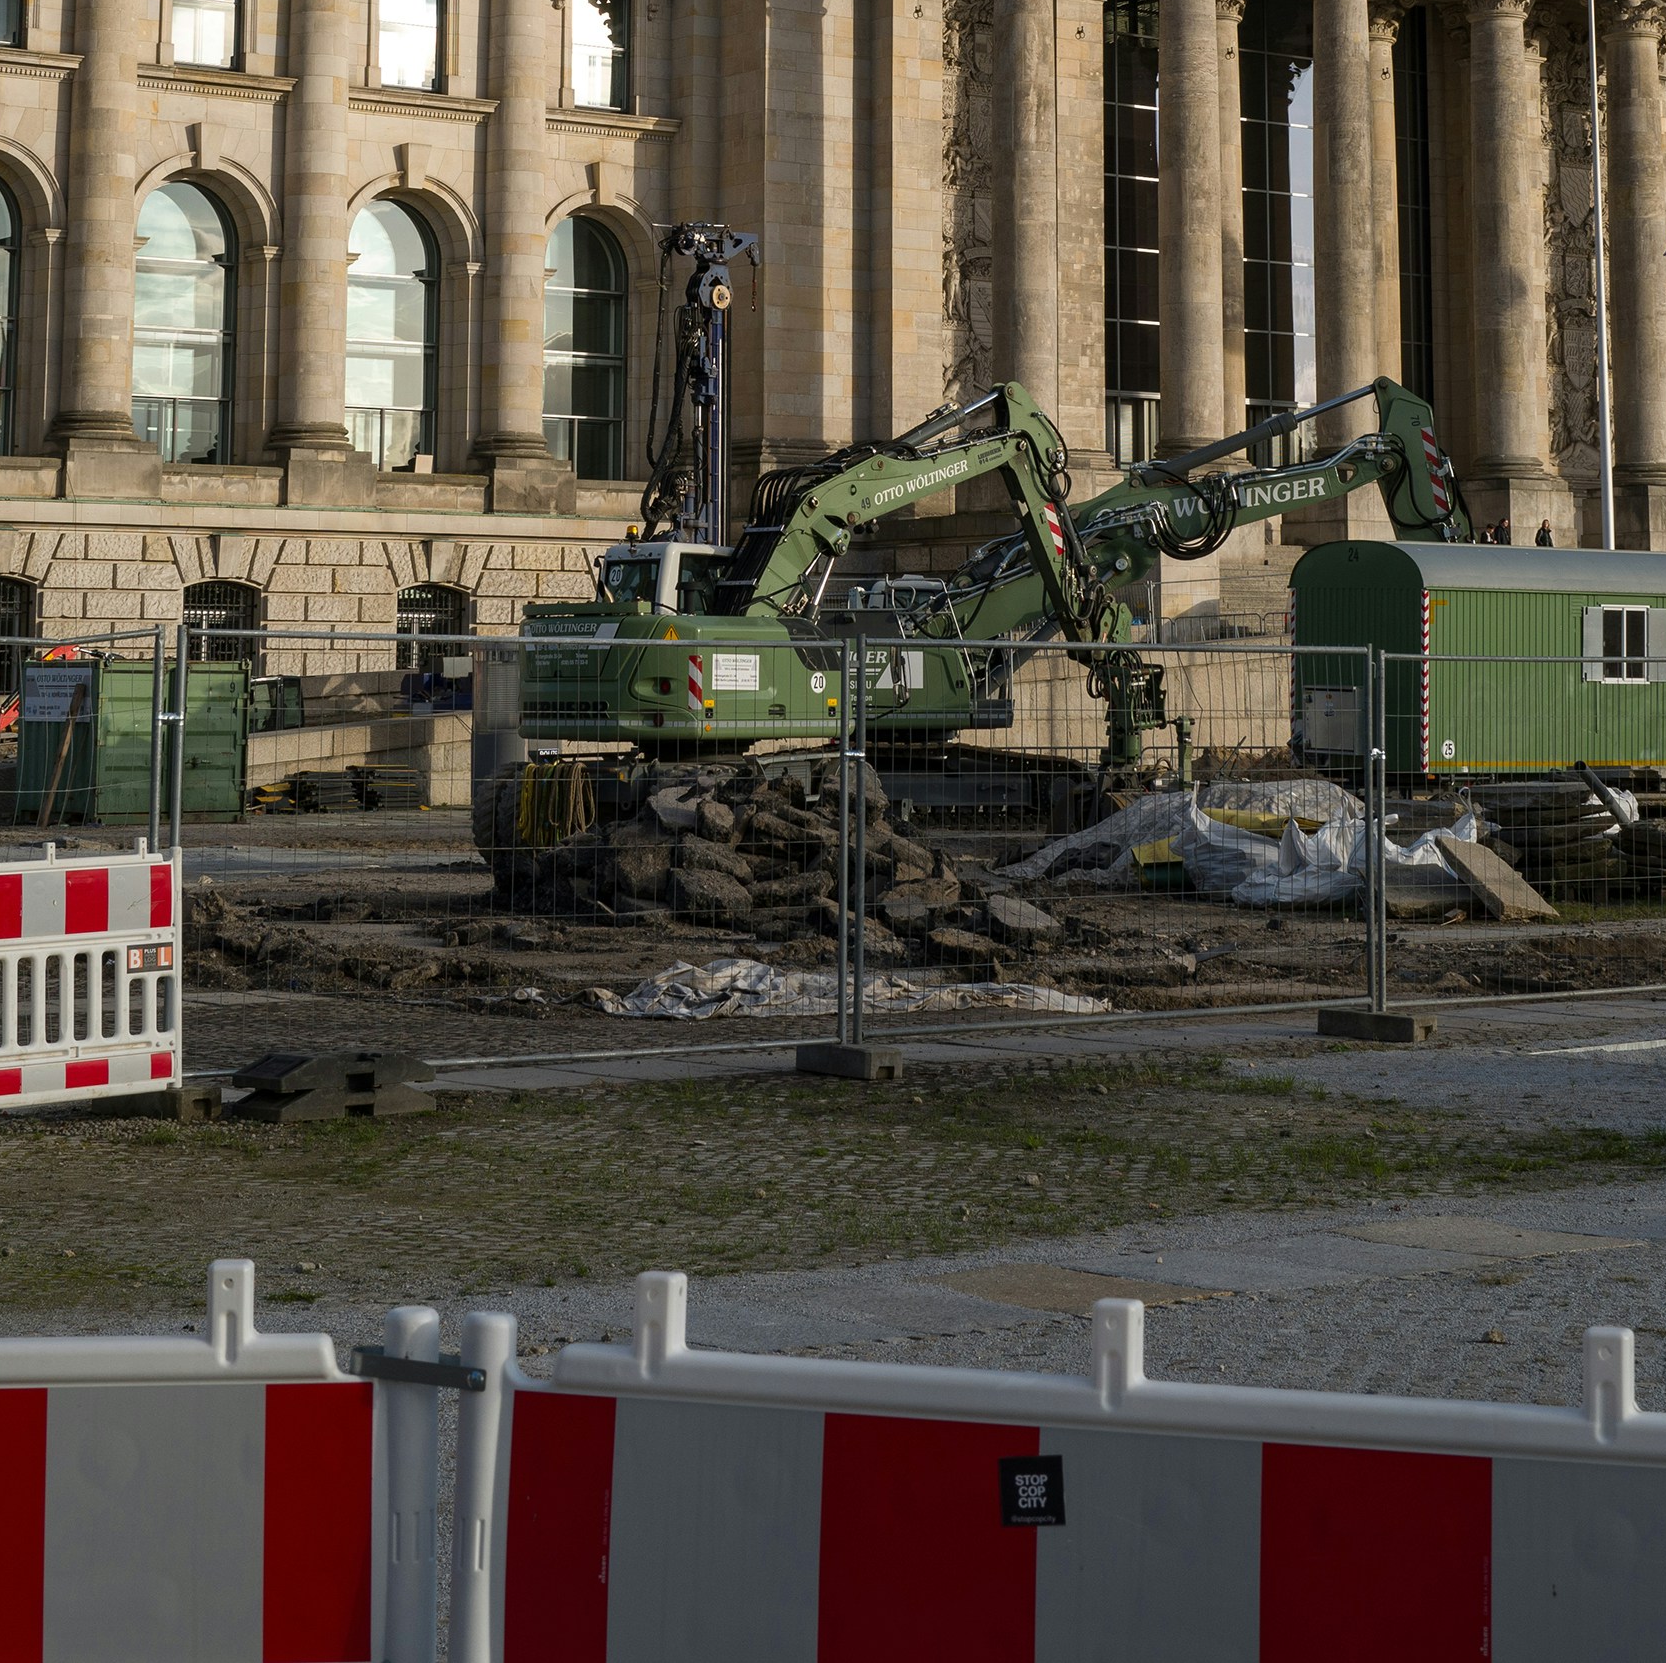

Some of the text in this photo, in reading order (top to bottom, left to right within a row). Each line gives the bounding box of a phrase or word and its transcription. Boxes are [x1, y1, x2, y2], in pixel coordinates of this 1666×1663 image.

[874, 459, 968, 506] OTTO WÖLTINGER
[861, 497, 871, 510] 49
[1347, 547, 1359, 563] 24
[611, 569, 621, 582] 20
[548, 621, 597, 633] WÖLTINGER
[230, 682, 235, 693] 9
[813, 676, 824, 689] 20
[1443, 740, 1453, 757] 25
[131, 949, 141, 969] B
[161, 947, 169, 966] L
[1015, 1474, 1048, 1486] STOP
[1018, 1486, 1046, 1497] COP
[1018, 1497, 1047, 1508] CITY
[598, 1555, 606, 1584] nissen
[1479, 1626, 1489, 1656] nissen
